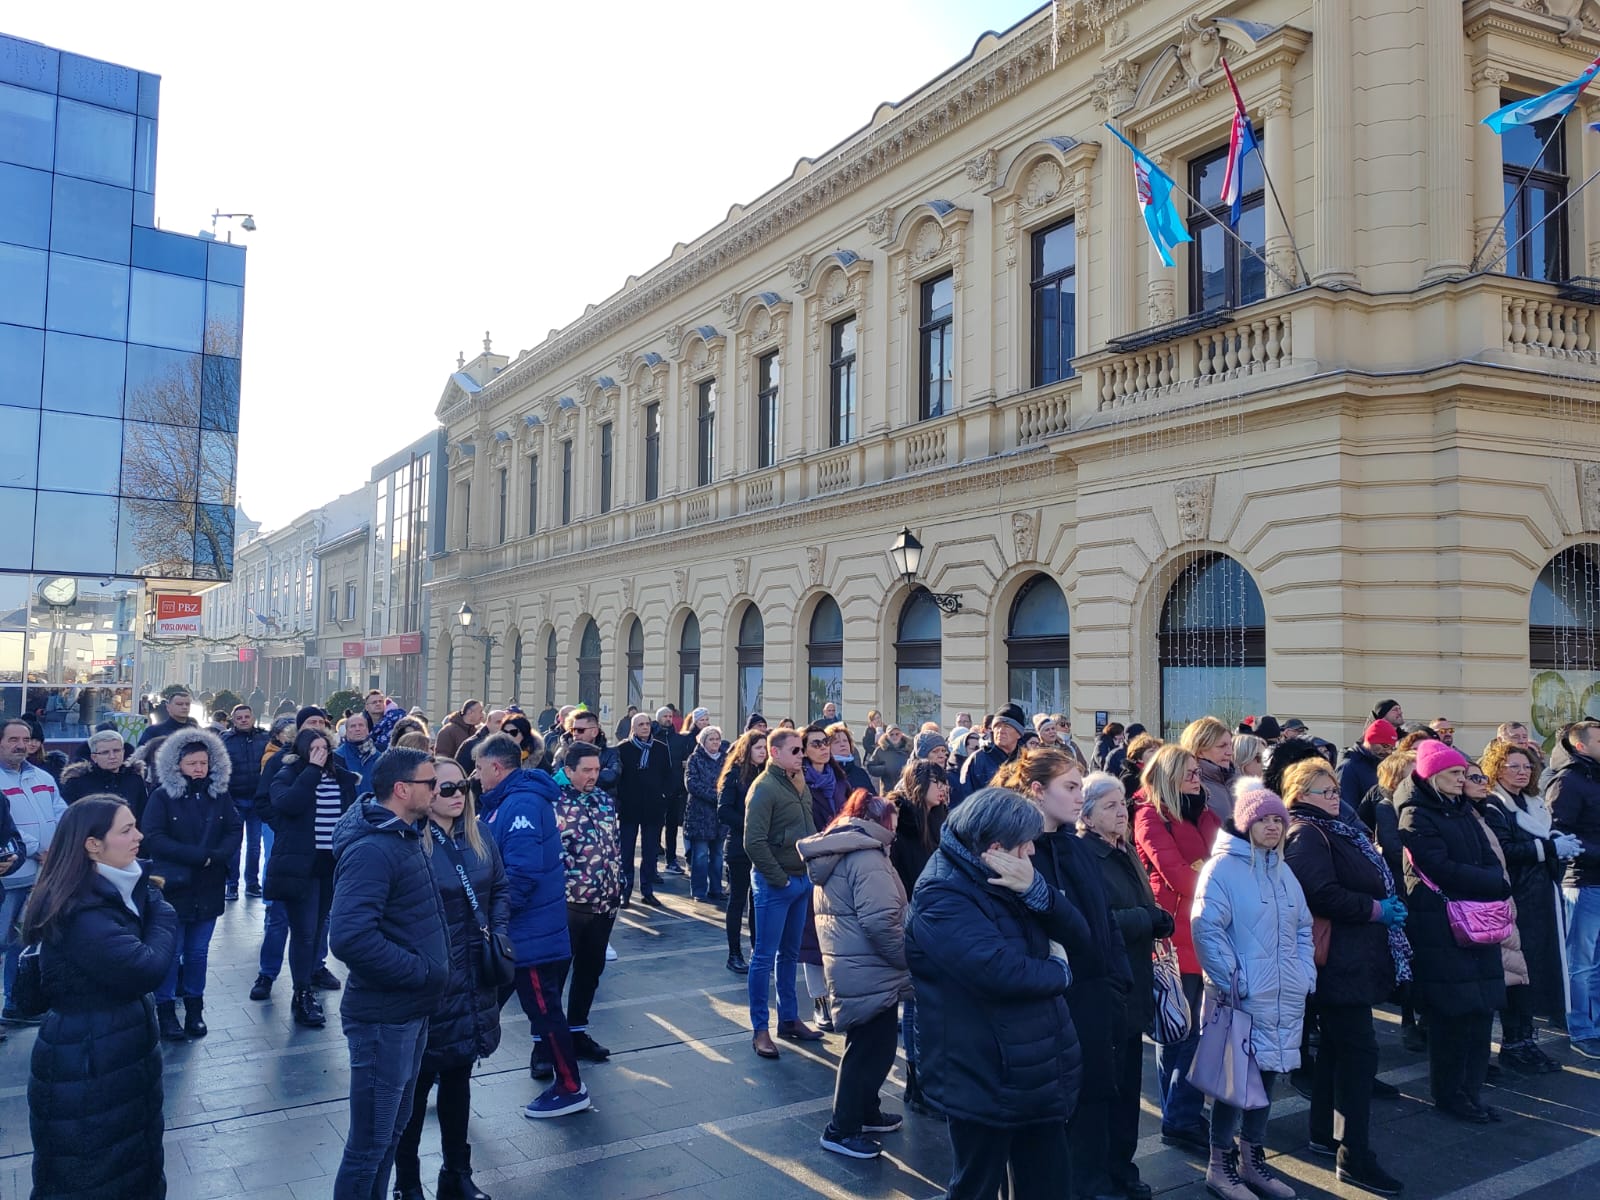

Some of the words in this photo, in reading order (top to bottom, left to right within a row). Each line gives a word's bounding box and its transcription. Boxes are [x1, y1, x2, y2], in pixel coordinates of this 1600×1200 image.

[178, 603, 199, 613] PBZ
[160, 623, 198, 632] POSLOVNICA
[456, 864, 479, 911] VALENTINO
